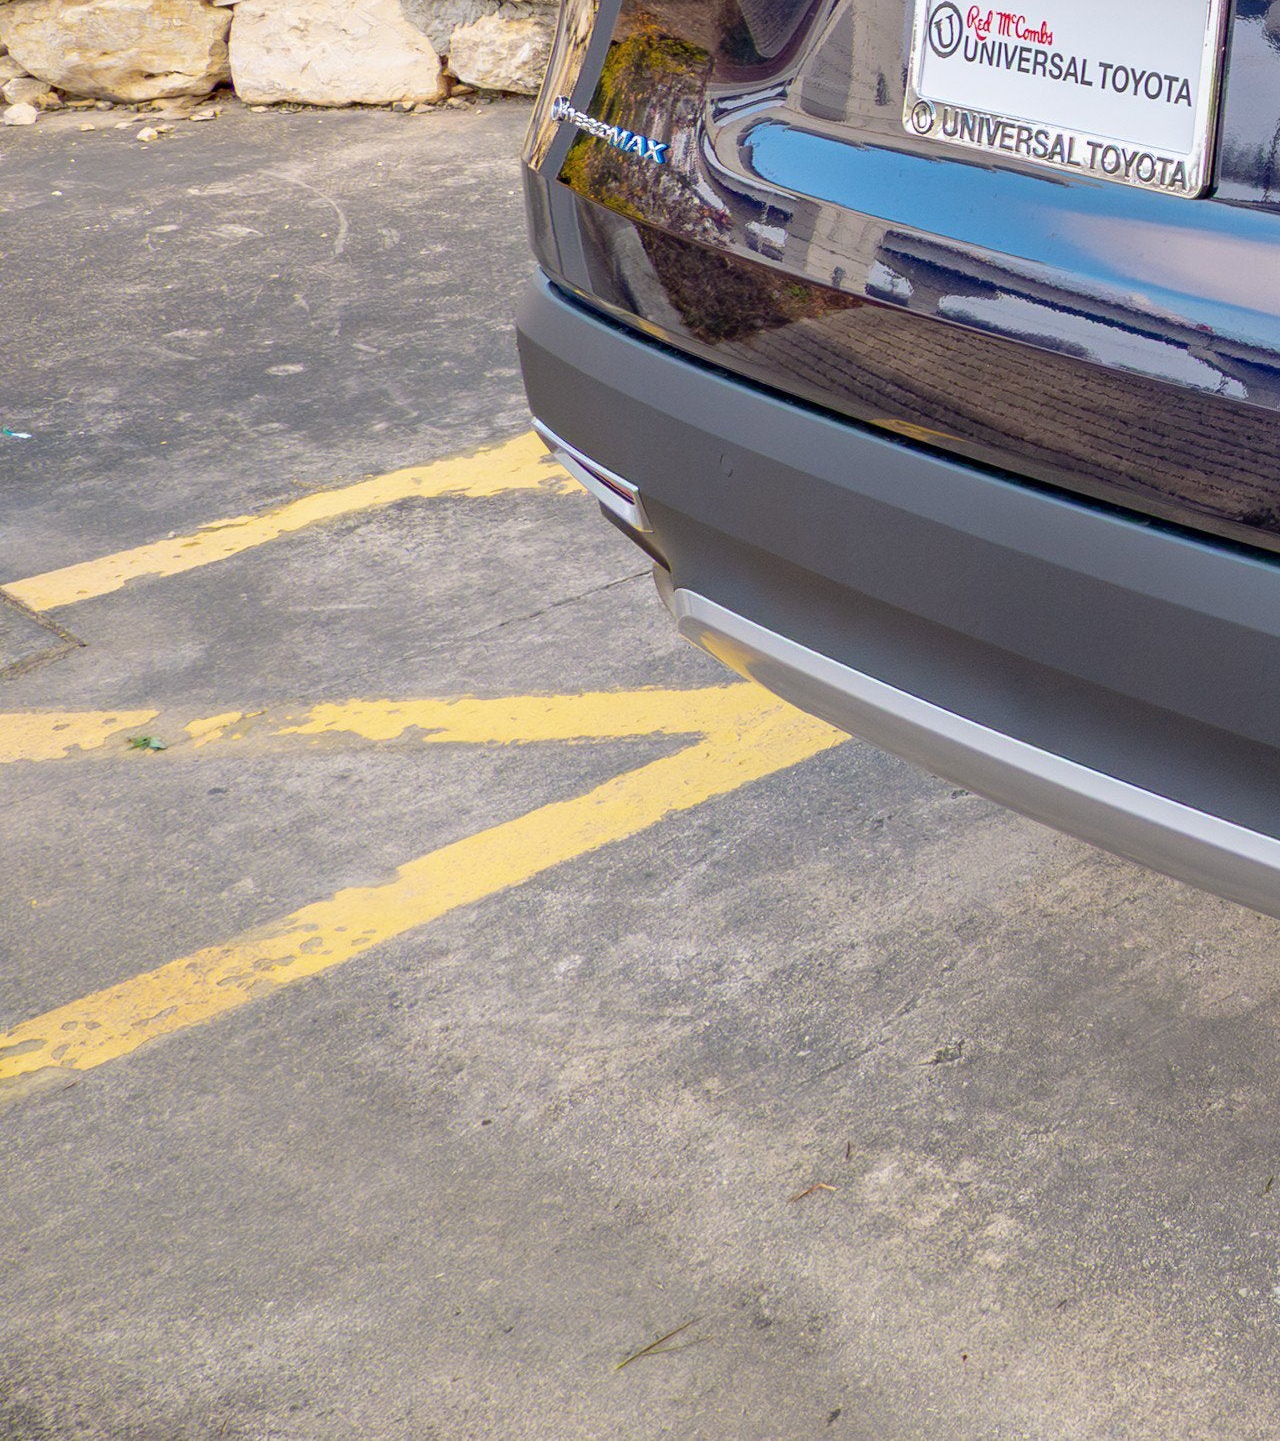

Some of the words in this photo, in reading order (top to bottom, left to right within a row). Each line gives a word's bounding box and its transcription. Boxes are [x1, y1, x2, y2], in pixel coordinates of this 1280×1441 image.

[967, 5, 992, 41] Red
[996, 12, 1053, 45] McCombs
[963, 35, 1093, 87] UNIVERSAL
[1099, 62, 1192, 107] TOYOTA
[943, 106, 1082, 166] UNIVERSAL
[1086, 140, 1189, 191] TOYOTA
